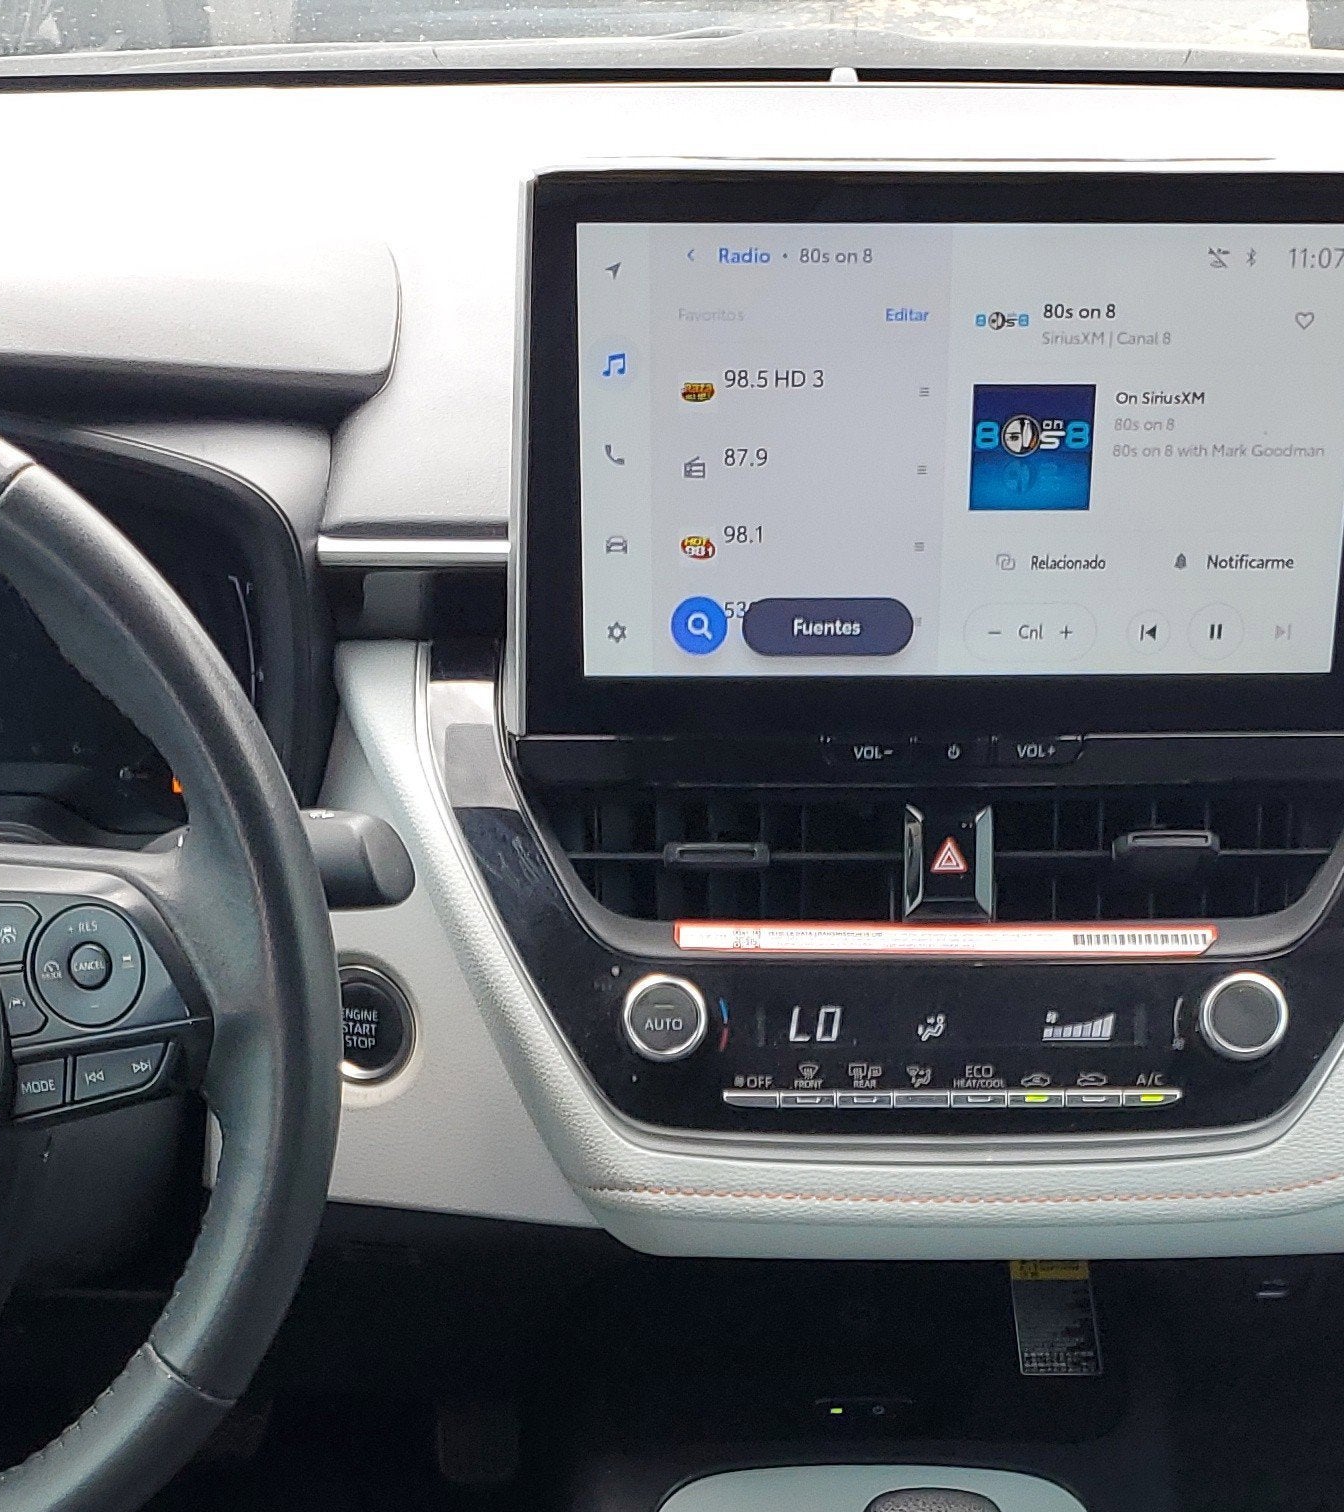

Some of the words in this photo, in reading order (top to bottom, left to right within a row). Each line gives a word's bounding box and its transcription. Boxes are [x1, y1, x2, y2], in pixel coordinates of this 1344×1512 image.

[718, 247, 771, 264] Radio
[799, 248, 830, 264] 80s
[835, 252, 858, 264] on
[862, 248, 873, 264] 8
[885, 307, 930, 322] Editar
[1043, 303, 1074, 319] 80s
[1078, 307, 1102, 319] on
[1105, 303, 1116, 319] 8
[1042, 331, 1105, 345] SiriusXM
[1117, 331, 1159, 345] Canal
[1161, 331, 1172, 345] 8
[723, 369, 768, 388] 98.5
[774, 369, 806, 388] HD
[812, 369, 825, 388] 3
[1115, 391, 1138, 405] On
[1142, 391, 1206, 405] SiriusXM
[1113, 417, 1140, 431] 80s
[1143, 421, 1163, 431] on
[1165, 417, 1175, 431] 8
[723, 448, 768, 467] 87.9
[1112, 444, 1138, 458] 80s
[1141, 448, 1161, 458] on
[1164, 444, 1173, 458] 8
[1177, 444, 1208, 458] with
[1211, 444, 1247, 458] Mark
[1251, 444, 1325, 458] Goodman
[723, 525, 764, 544] 98.1
[1030, 554, 1106, 571] Relacionado
[1206, 554, 1295, 571] Notificarme
[724, 601, 754, 619] 53
[792, 617, 862, 637] Fuentes
[1018, 624, 1045, 641] Cnl
[73, 960, 106, 972] CANCEL
[342, 1021, 377, 1036] START
[644, 1018, 683, 1031] AUTO
[788, 1005, 843, 1042] LO
[345, 1035, 376, 1050] STOP
[965, 1065, 993, 1078] ECO
[20, 1078, 56, 1095] MODE
[746, 1075, 773, 1088] OFF
[794, 1079, 824, 1089] FRONT
[853, 1079, 877, 1089] REAR
[953, 1078, 1005, 1089] HEAT/COOL
[1136, 1073, 1164, 1087] A/C
